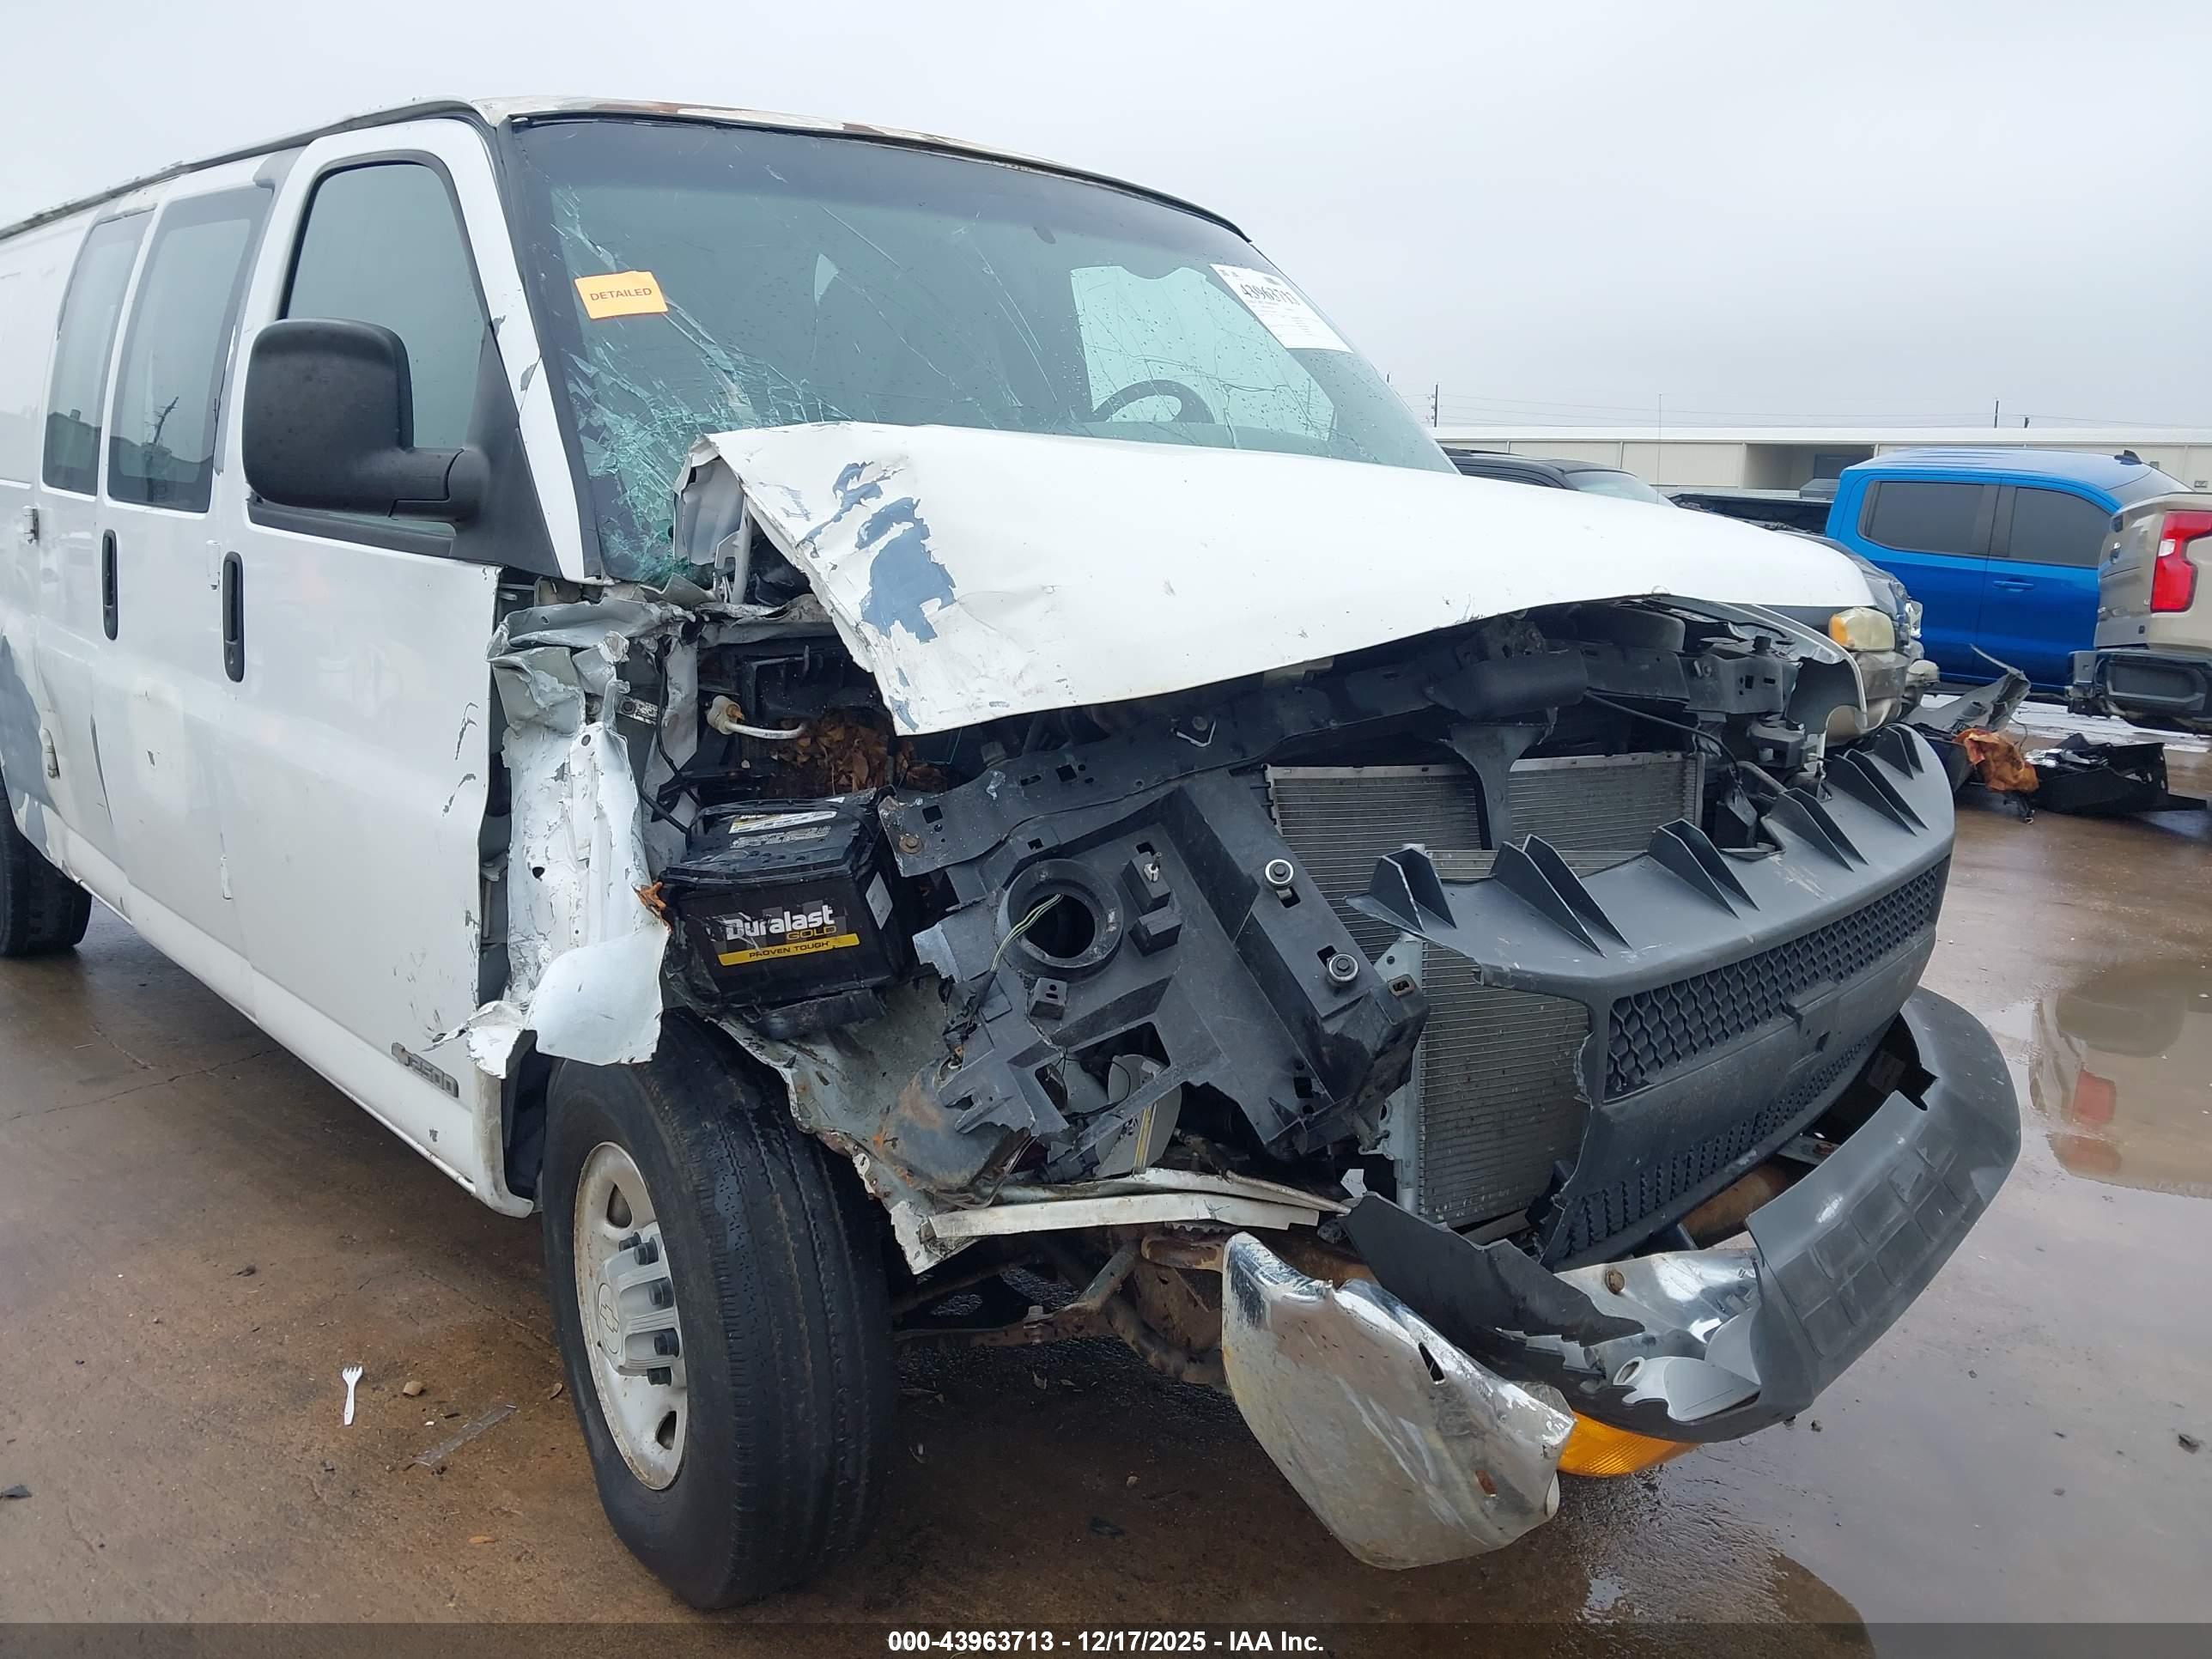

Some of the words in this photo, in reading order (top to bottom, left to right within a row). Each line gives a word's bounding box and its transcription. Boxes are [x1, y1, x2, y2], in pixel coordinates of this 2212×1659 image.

[590, 288, 652, 301] DETAILED
[726, 904, 835, 940] Duralast
[786, 925, 837, 940] GOLD
[749, 946, 791, 959] PROVEN
[793, 940, 830, 953] TOUGH
